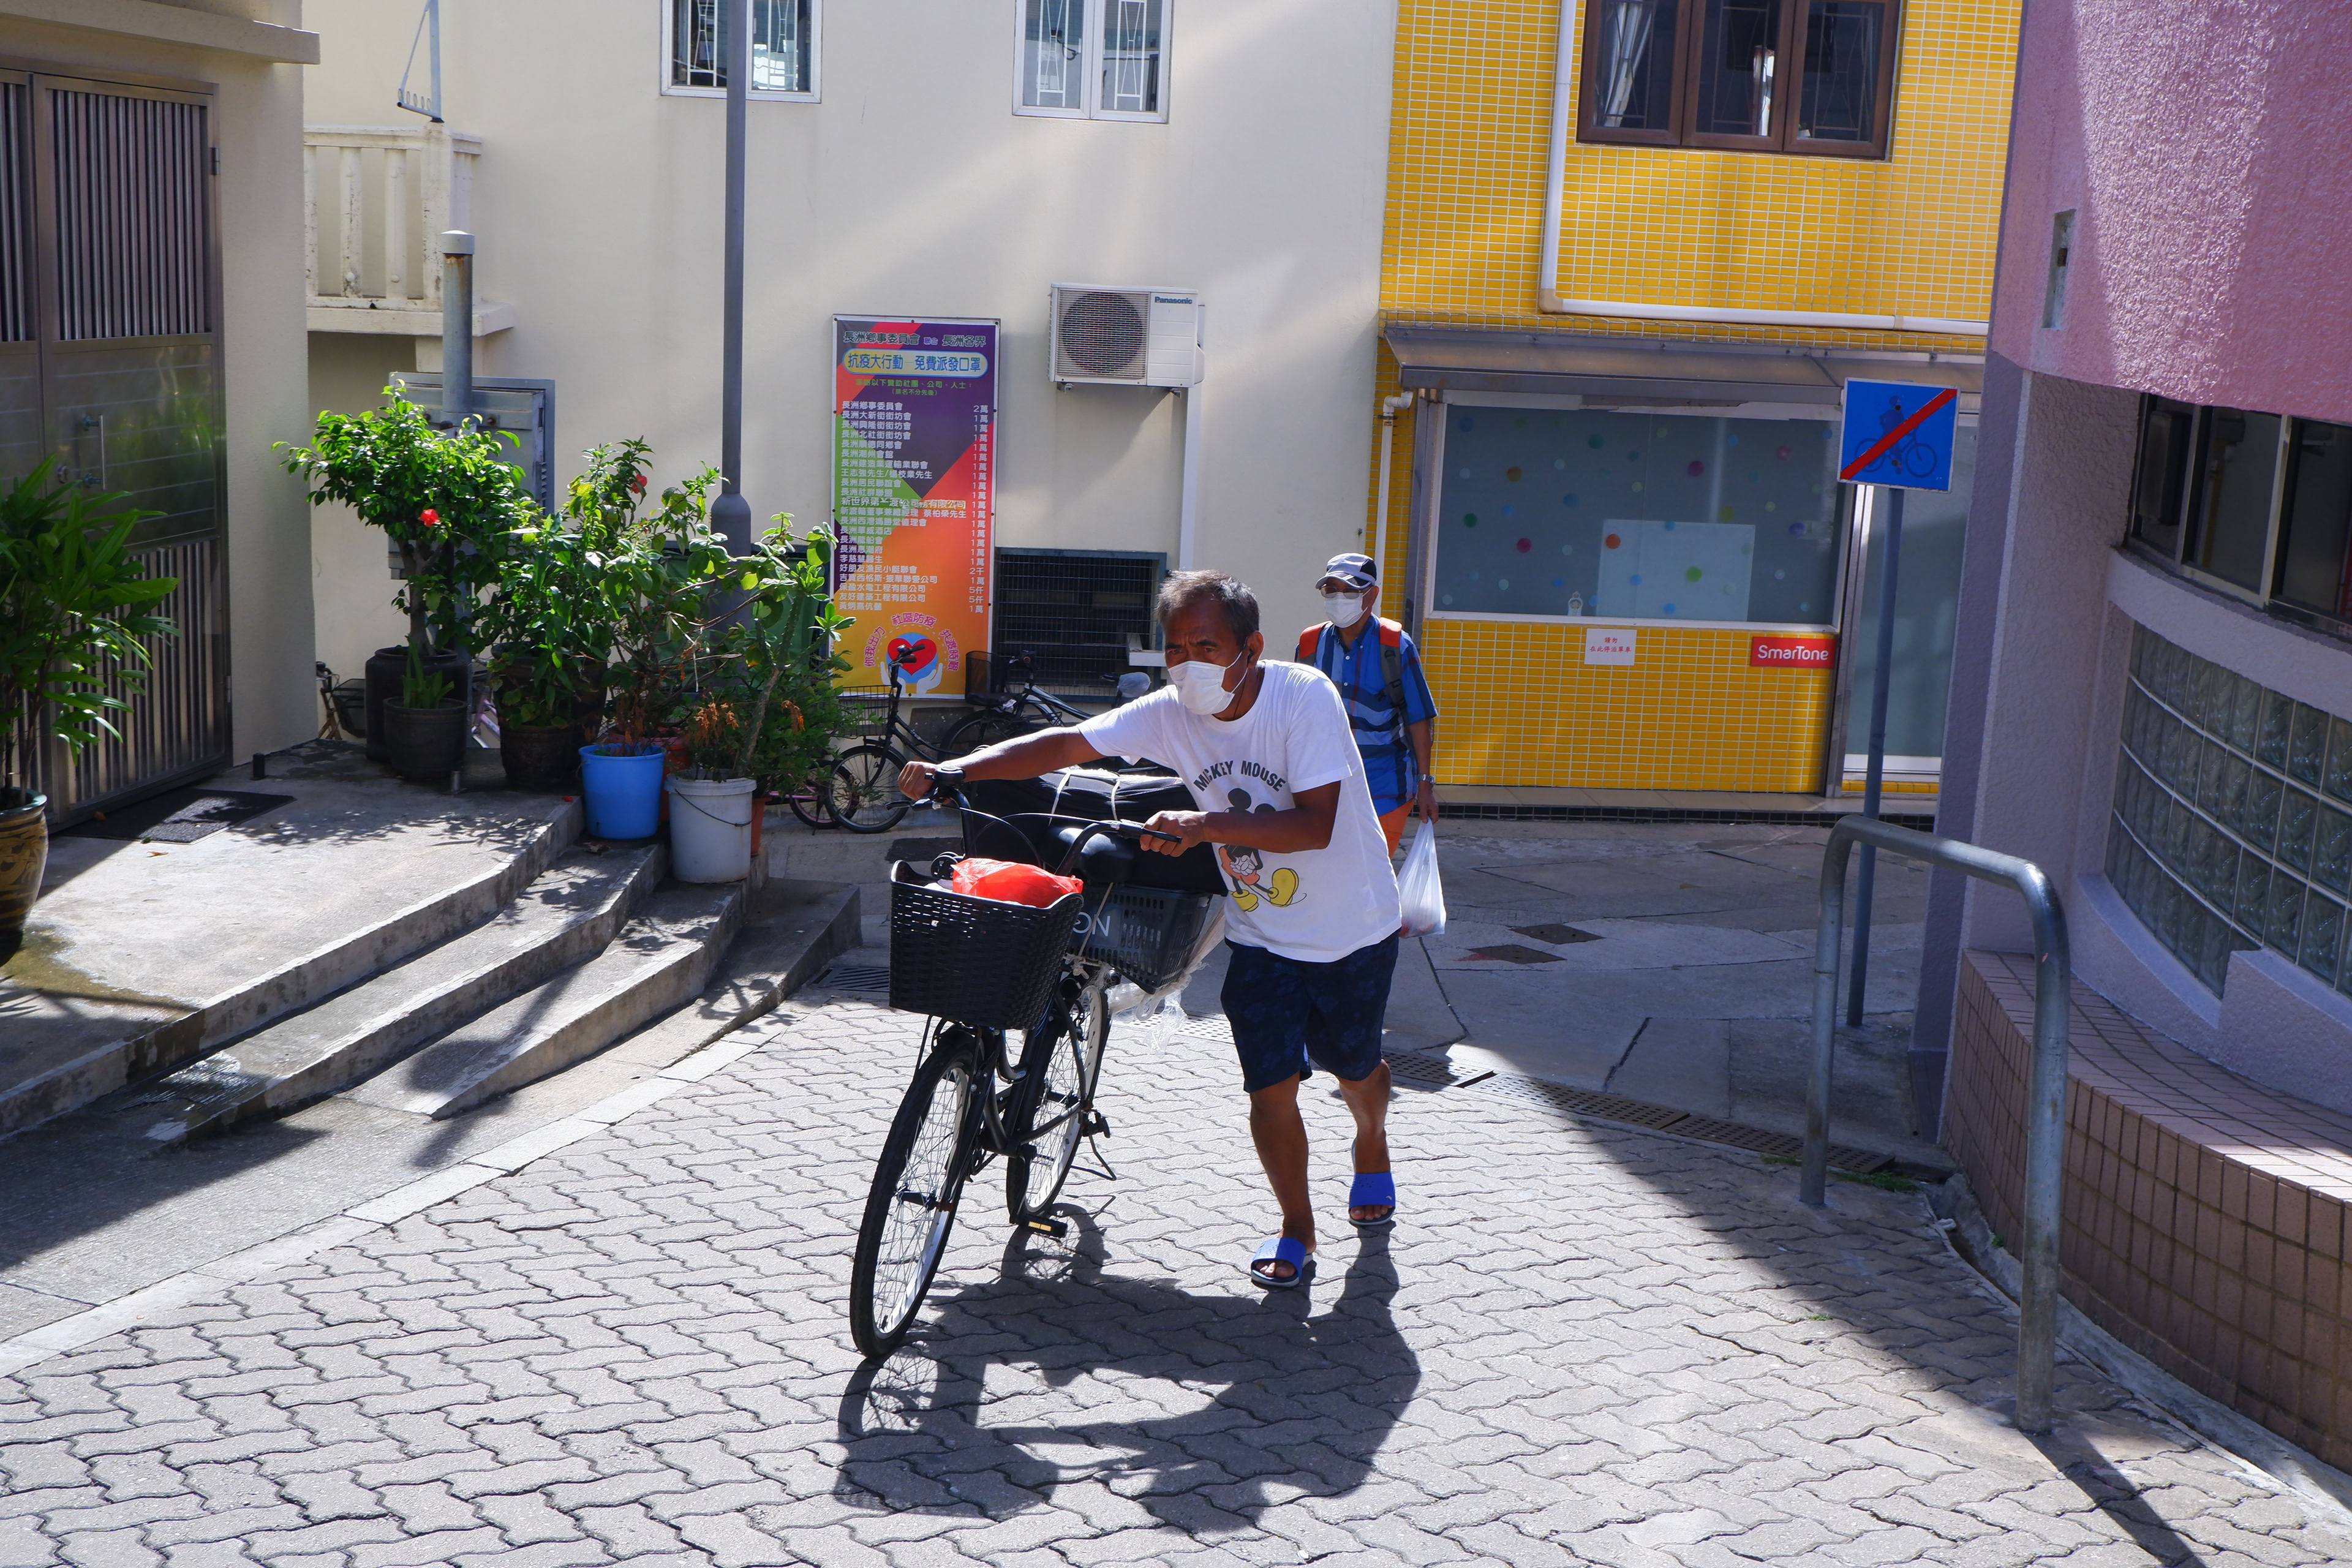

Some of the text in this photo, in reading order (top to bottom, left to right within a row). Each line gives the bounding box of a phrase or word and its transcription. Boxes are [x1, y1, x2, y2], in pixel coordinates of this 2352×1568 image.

[843, 331, 920, 345] 長洲鄉事委員會
[942, 334, 987, 347] 長洲各界
[842, 401, 903, 411] 長洲鄉事委員會
[842, 430, 911, 440] 長洲北社街街坊會
[891, 612, 937, 628] 社區防疫
[864, 626, 886, 668] 你我出力
[938, 628, 960, 671] 共渡時艱
[1589, 645, 1631, 654] 在此停泊單車
[1757, 644, 1829, 660] SmarTone
[1193, 760, 1286, 792] MICKEY MOUSE
